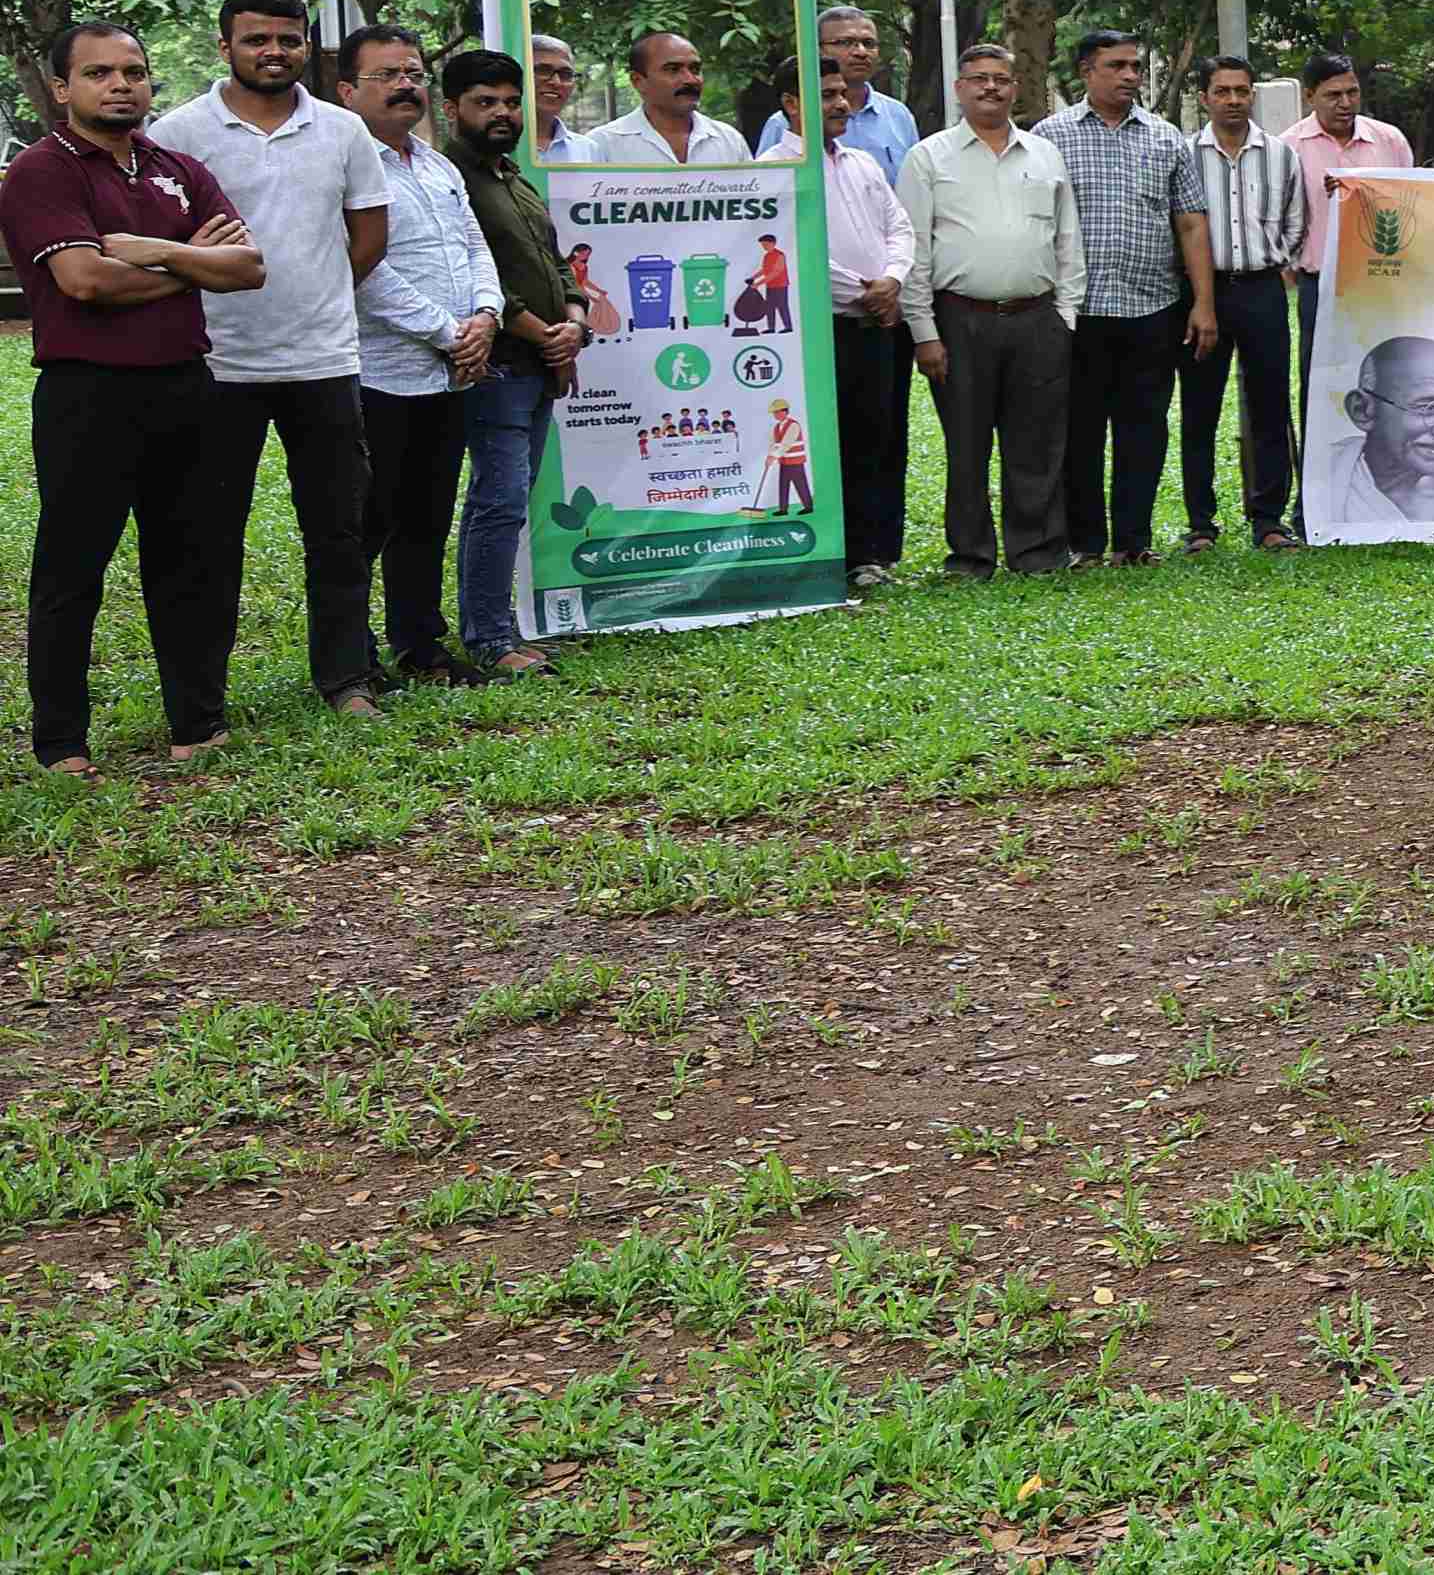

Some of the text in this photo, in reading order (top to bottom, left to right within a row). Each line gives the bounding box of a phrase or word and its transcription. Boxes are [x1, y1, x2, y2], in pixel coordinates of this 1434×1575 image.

[589, 177, 760, 198] I am committed towards
[569, 197, 778, 225] CLEANLINESS
[570, 388, 616, 400] A clean
[567, 401, 632, 414] tomorrow
[566, 413, 642, 429] starts today
[648, 463, 742, 483] स्वच्छता हमारी
[647, 483, 751, 504] जिम्मेदारी हमारी
[608, 535, 785, 564] Celebrate Cleanliness
